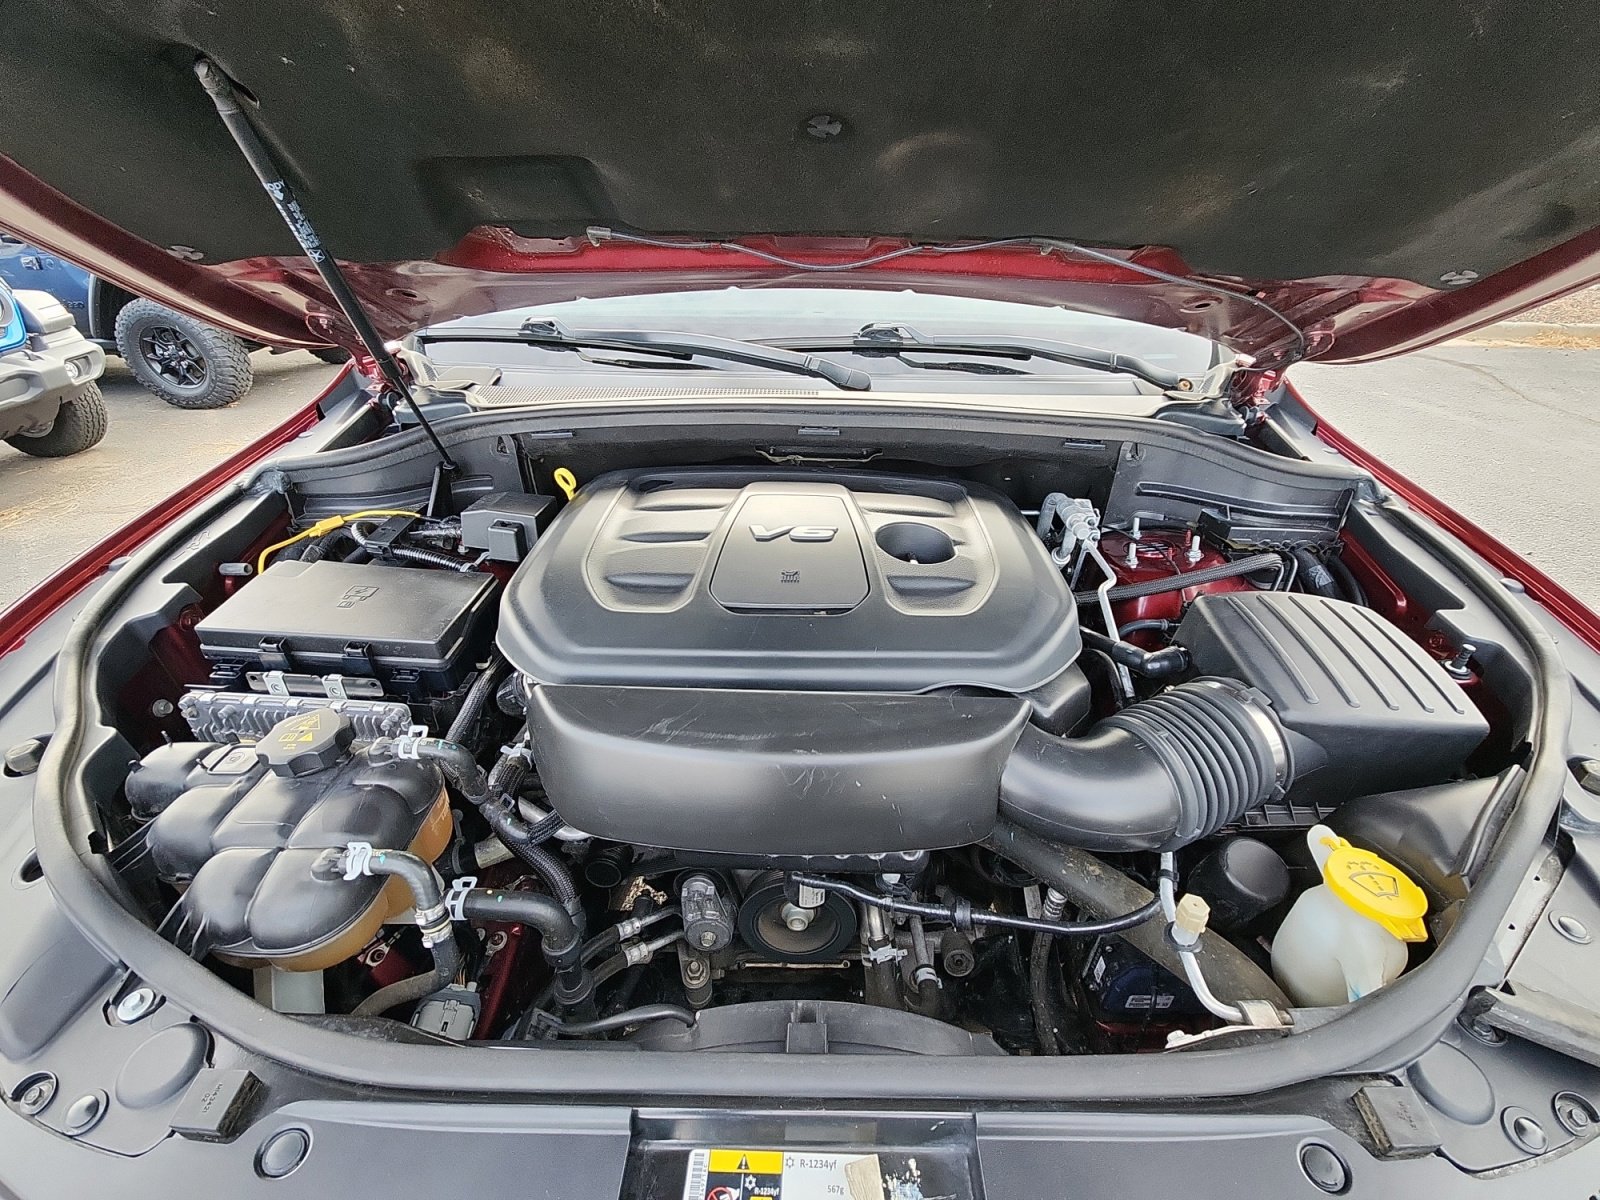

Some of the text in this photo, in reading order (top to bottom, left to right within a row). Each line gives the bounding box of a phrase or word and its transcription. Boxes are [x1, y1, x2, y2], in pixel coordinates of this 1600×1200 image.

[266, 180, 285, 191] ODY
[748, 524, 839, 543] V6
[799, 1158, 837, 1170] R-1234yf
[754, 1186, 780, 1196] R-1234yf
[827, 1184, 844, 1195] 567g
